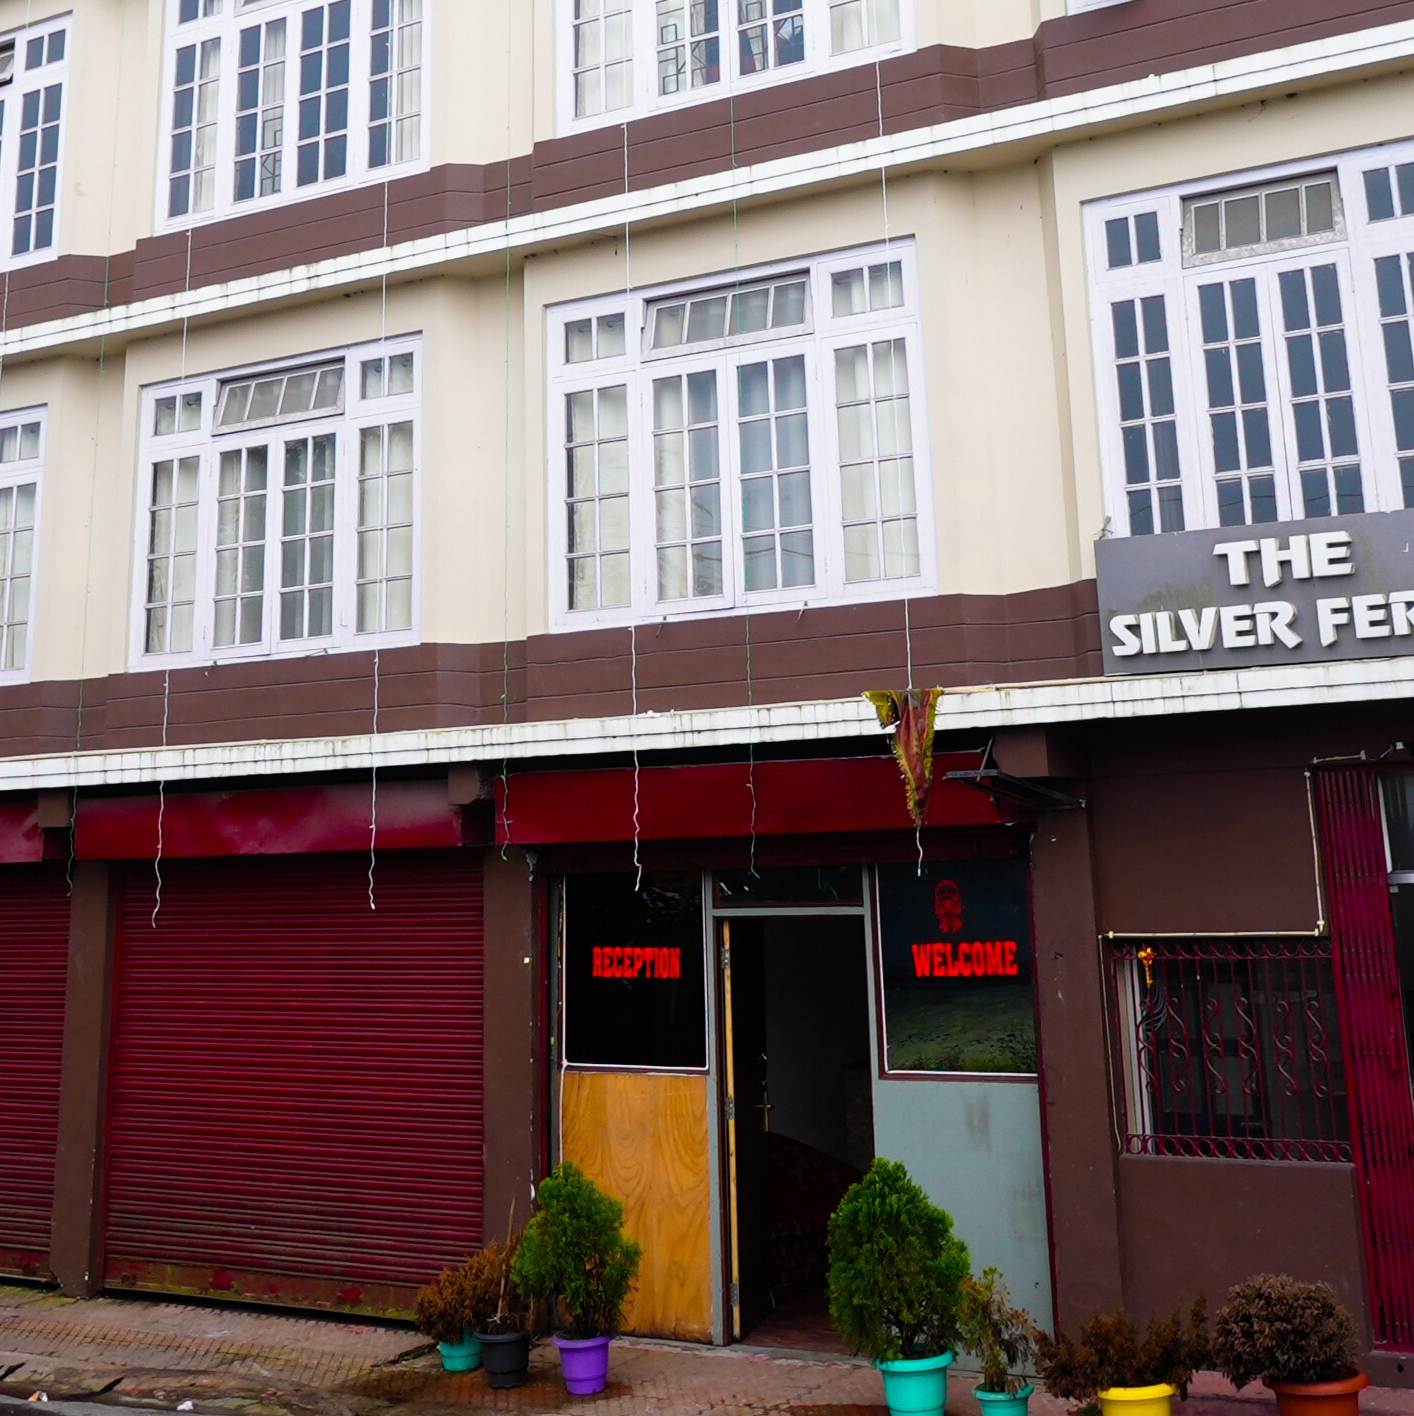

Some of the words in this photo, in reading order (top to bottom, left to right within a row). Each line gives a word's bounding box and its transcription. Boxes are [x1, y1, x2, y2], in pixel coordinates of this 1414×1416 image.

[1213, 530, 1355, 587] THE
[1108, 600, 1303, 657] SILVER
[592, 946, 681, 979] RECEPTION
[911, 941, 1018, 977] WELCOME
